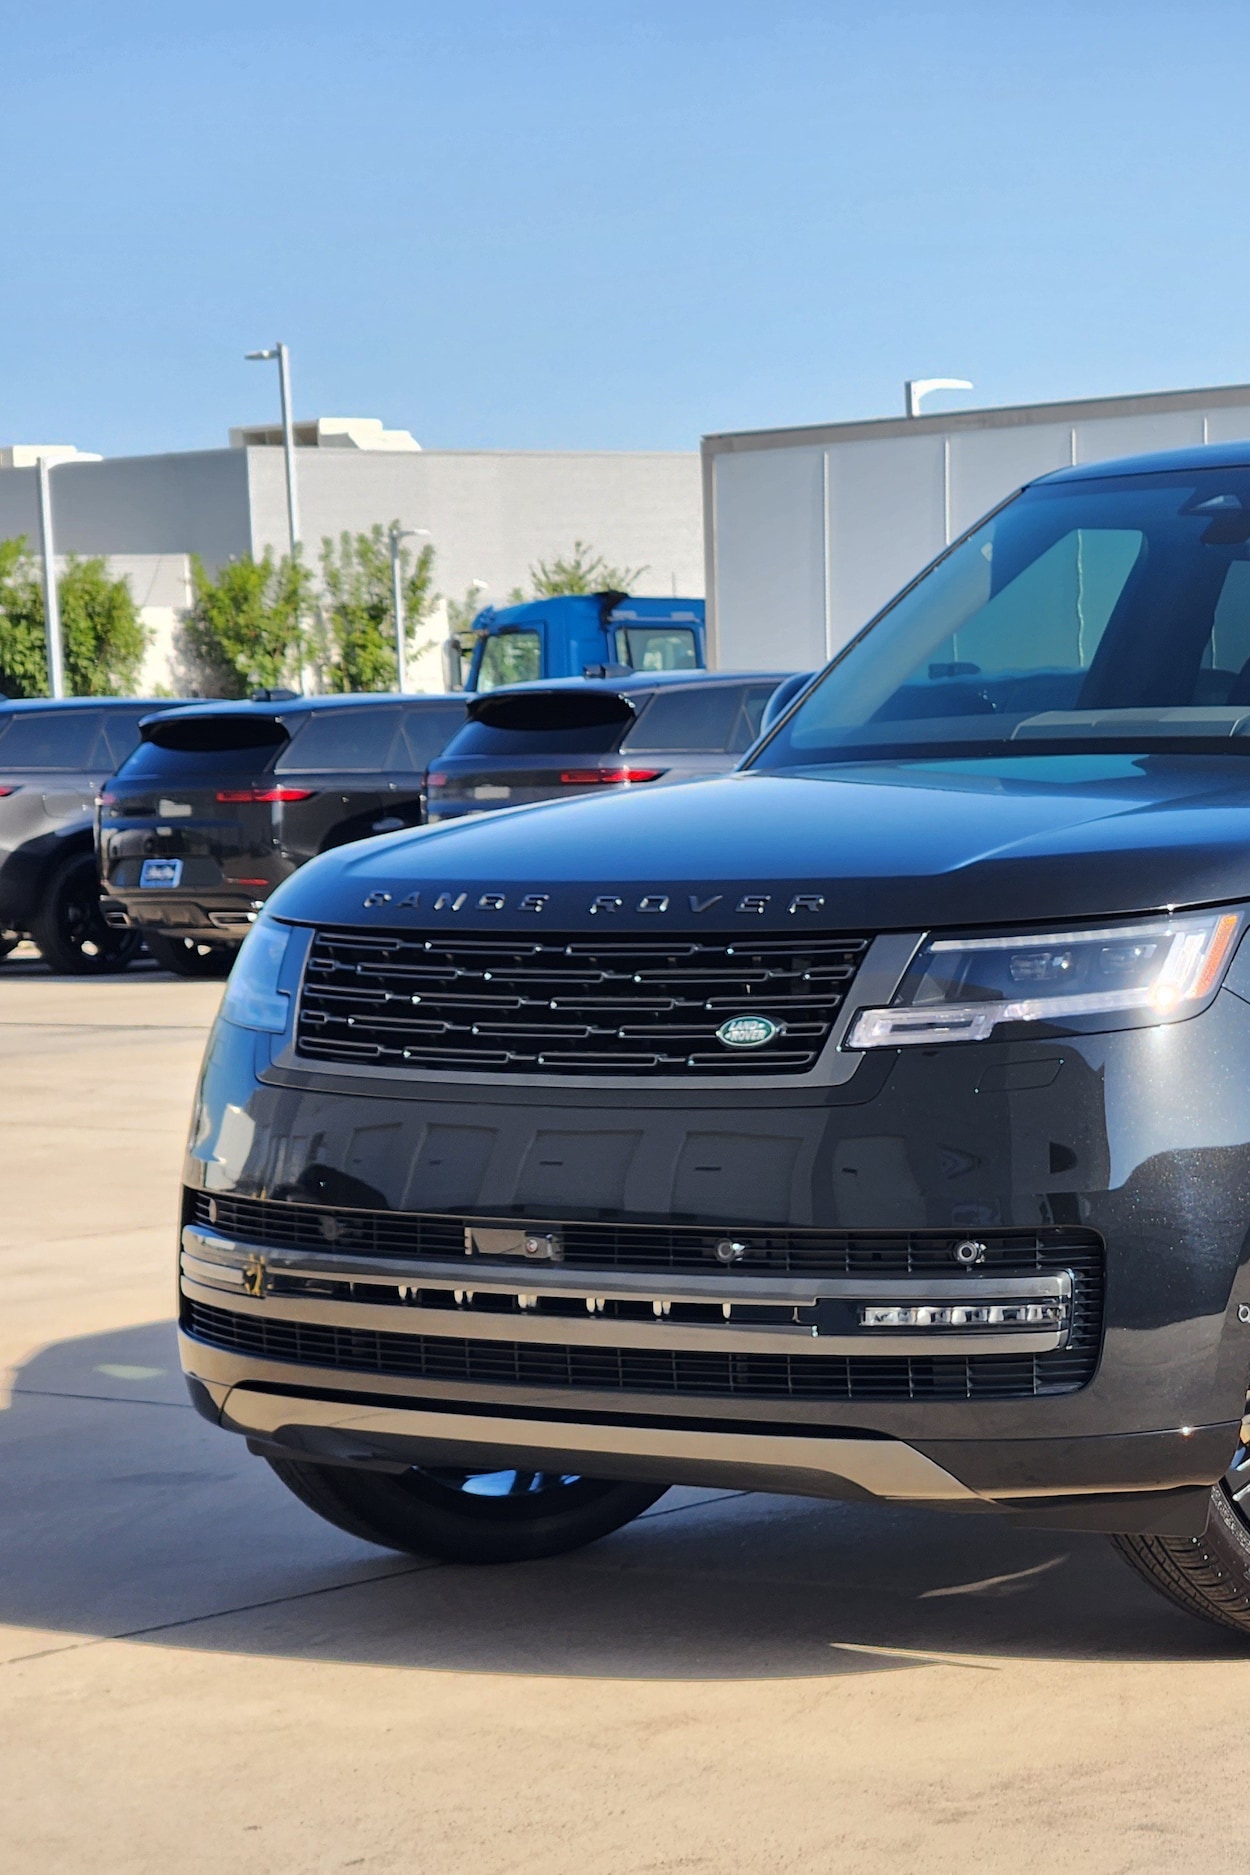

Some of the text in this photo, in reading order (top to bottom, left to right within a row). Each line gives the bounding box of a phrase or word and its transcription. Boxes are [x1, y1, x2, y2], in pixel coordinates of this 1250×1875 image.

[363, 889, 825, 913] RANGE ROVER
[728, 1020, 758, 1031] LAND
[730, 1030, 766, 1041] ROVER
